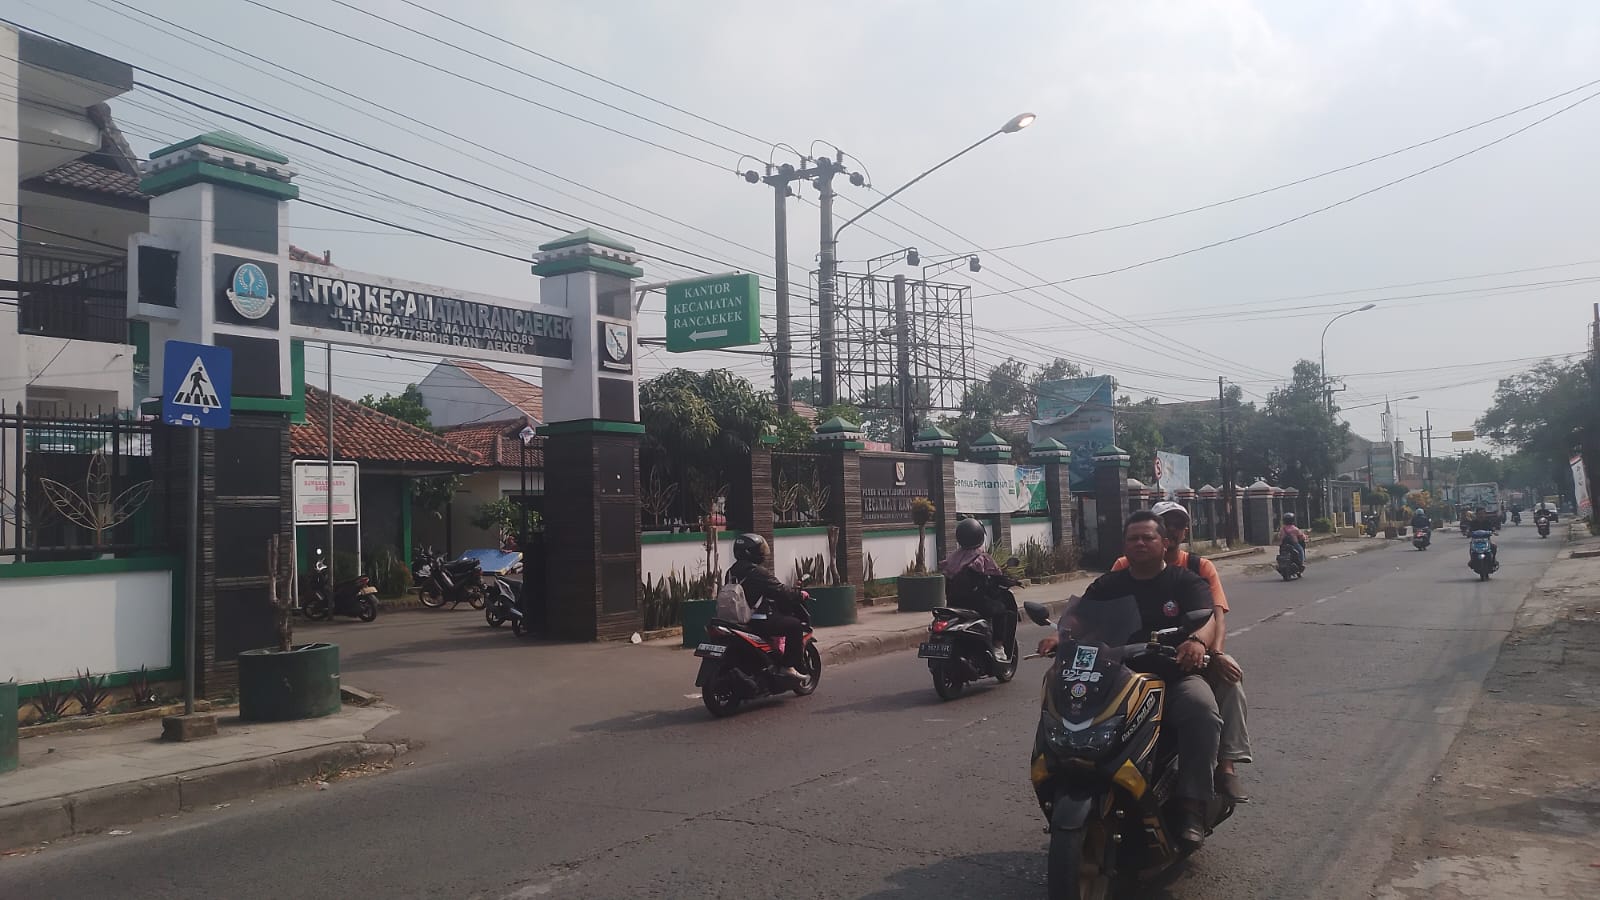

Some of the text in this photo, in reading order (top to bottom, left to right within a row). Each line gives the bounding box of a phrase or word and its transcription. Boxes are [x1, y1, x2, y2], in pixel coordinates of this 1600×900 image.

[684, 282, 731, 299] KANTOR
[365, 286, 476, 327] KECAMATAN
[478, 304, 573, 340] RANCAEKEK
[673, 295, 743, 315] KECAMATAN
[673, 311, 743, 329] RANCAEKEK
